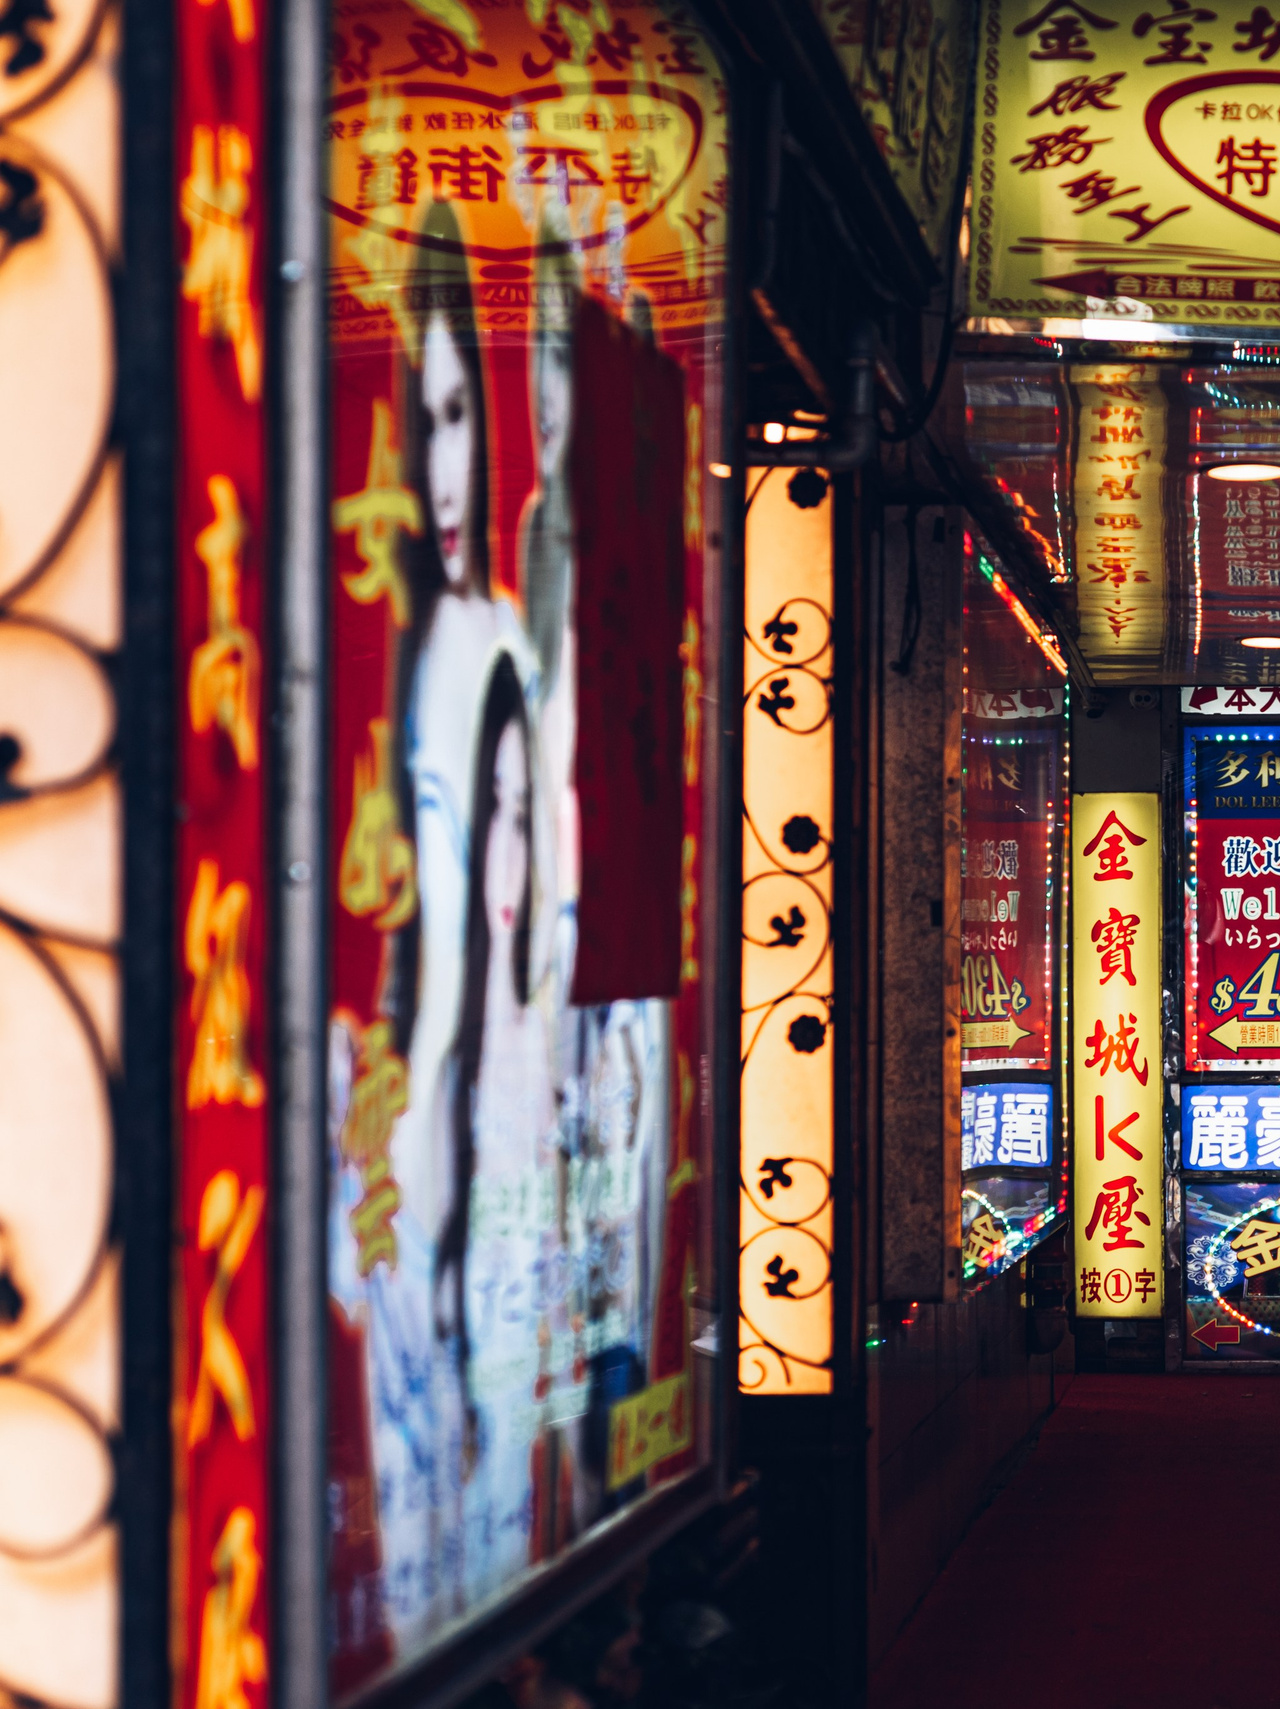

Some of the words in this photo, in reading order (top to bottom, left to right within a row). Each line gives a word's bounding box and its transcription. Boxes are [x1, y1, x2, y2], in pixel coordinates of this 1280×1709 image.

[1114, 276, 1235, 297] 合法牌照
[1214, 796, 1248, 808] DOL
